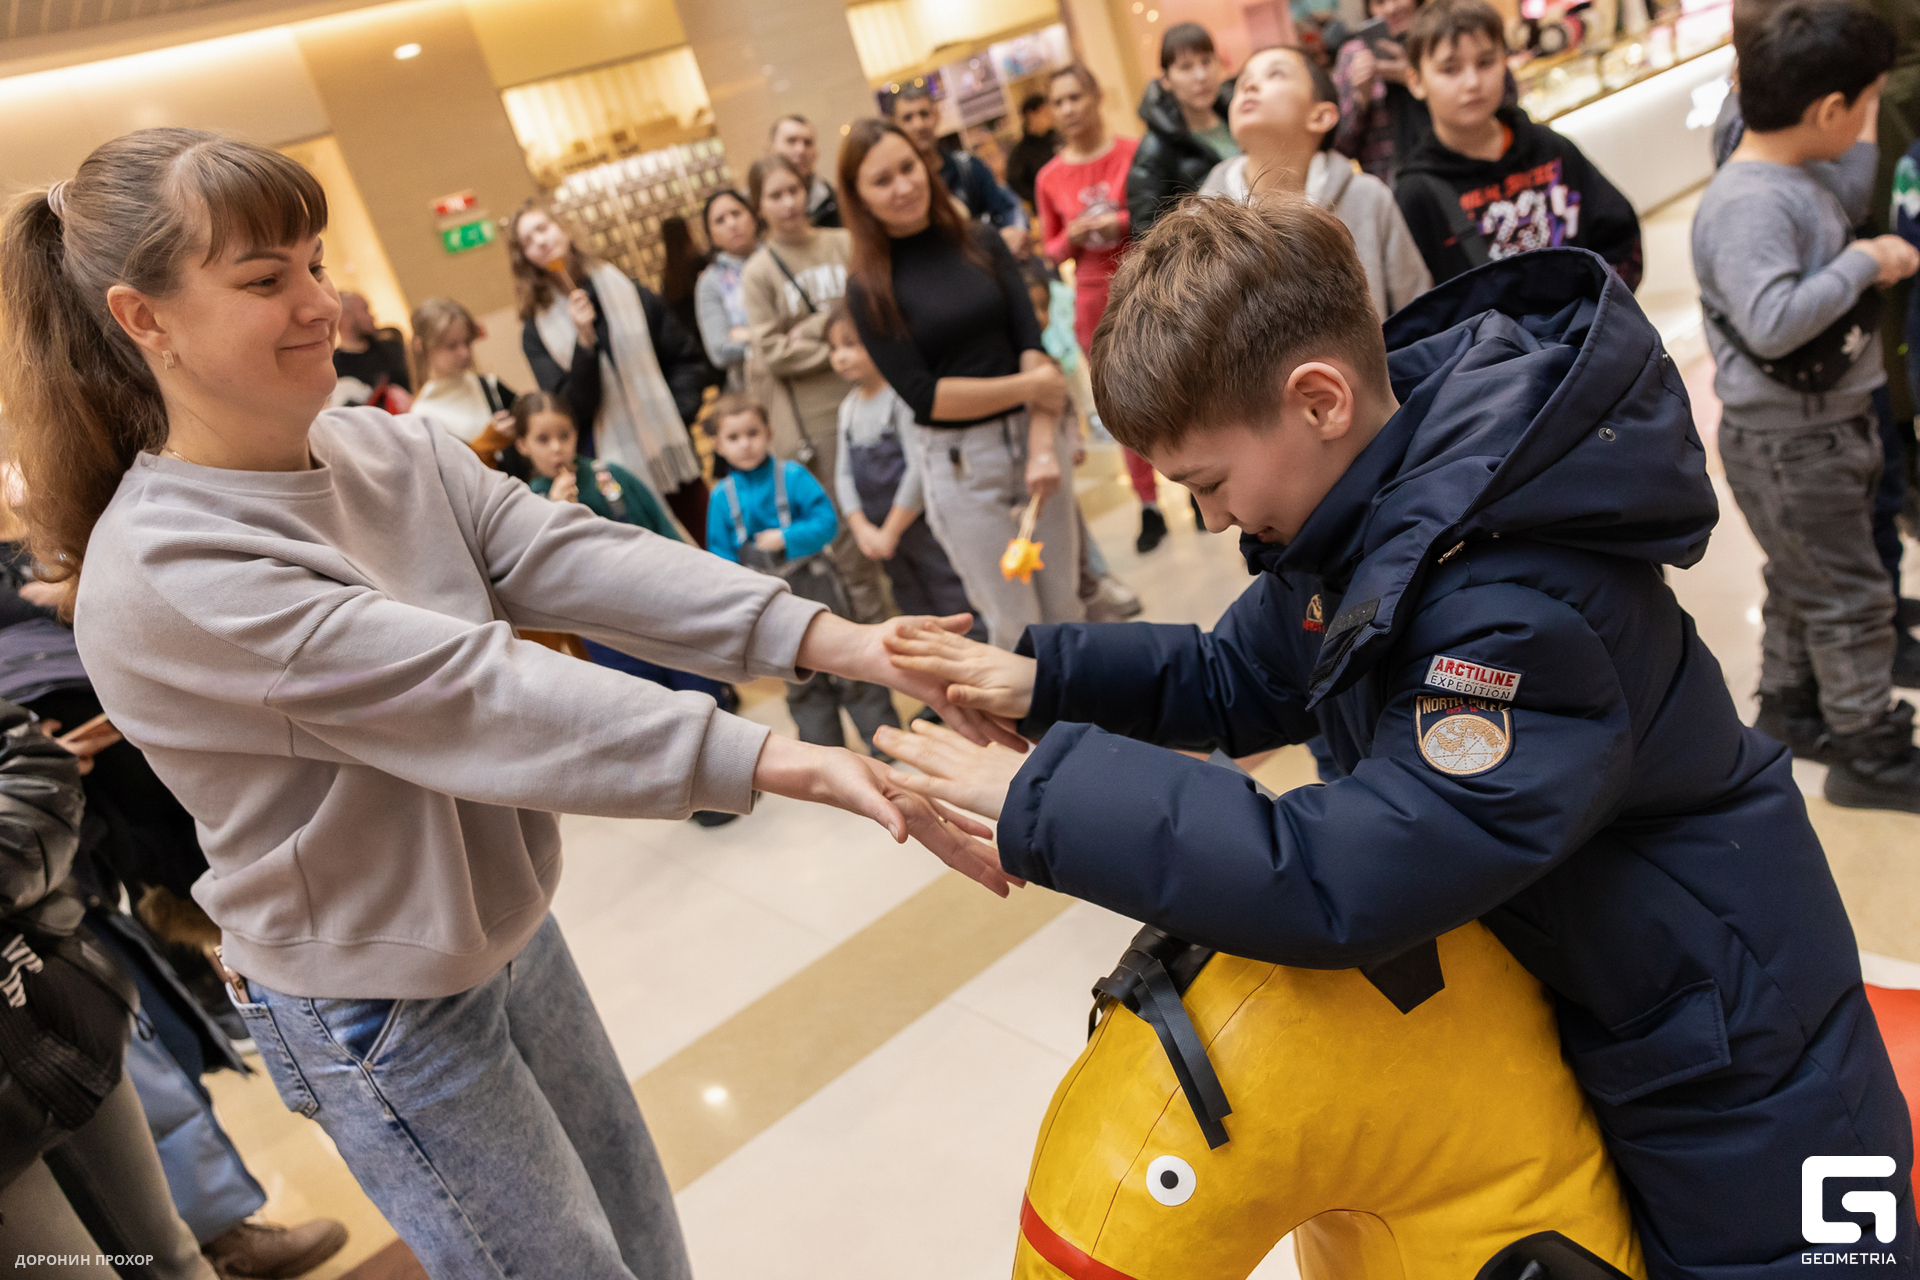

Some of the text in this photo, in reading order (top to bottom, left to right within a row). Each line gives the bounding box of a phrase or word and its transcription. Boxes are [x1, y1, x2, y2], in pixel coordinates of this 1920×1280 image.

[1434, 658, 1517, 687] ARCTILINE
[1430, 675, 1511, 700] EXPEDITION
[1422, 697, 1464, 714] NORTH
